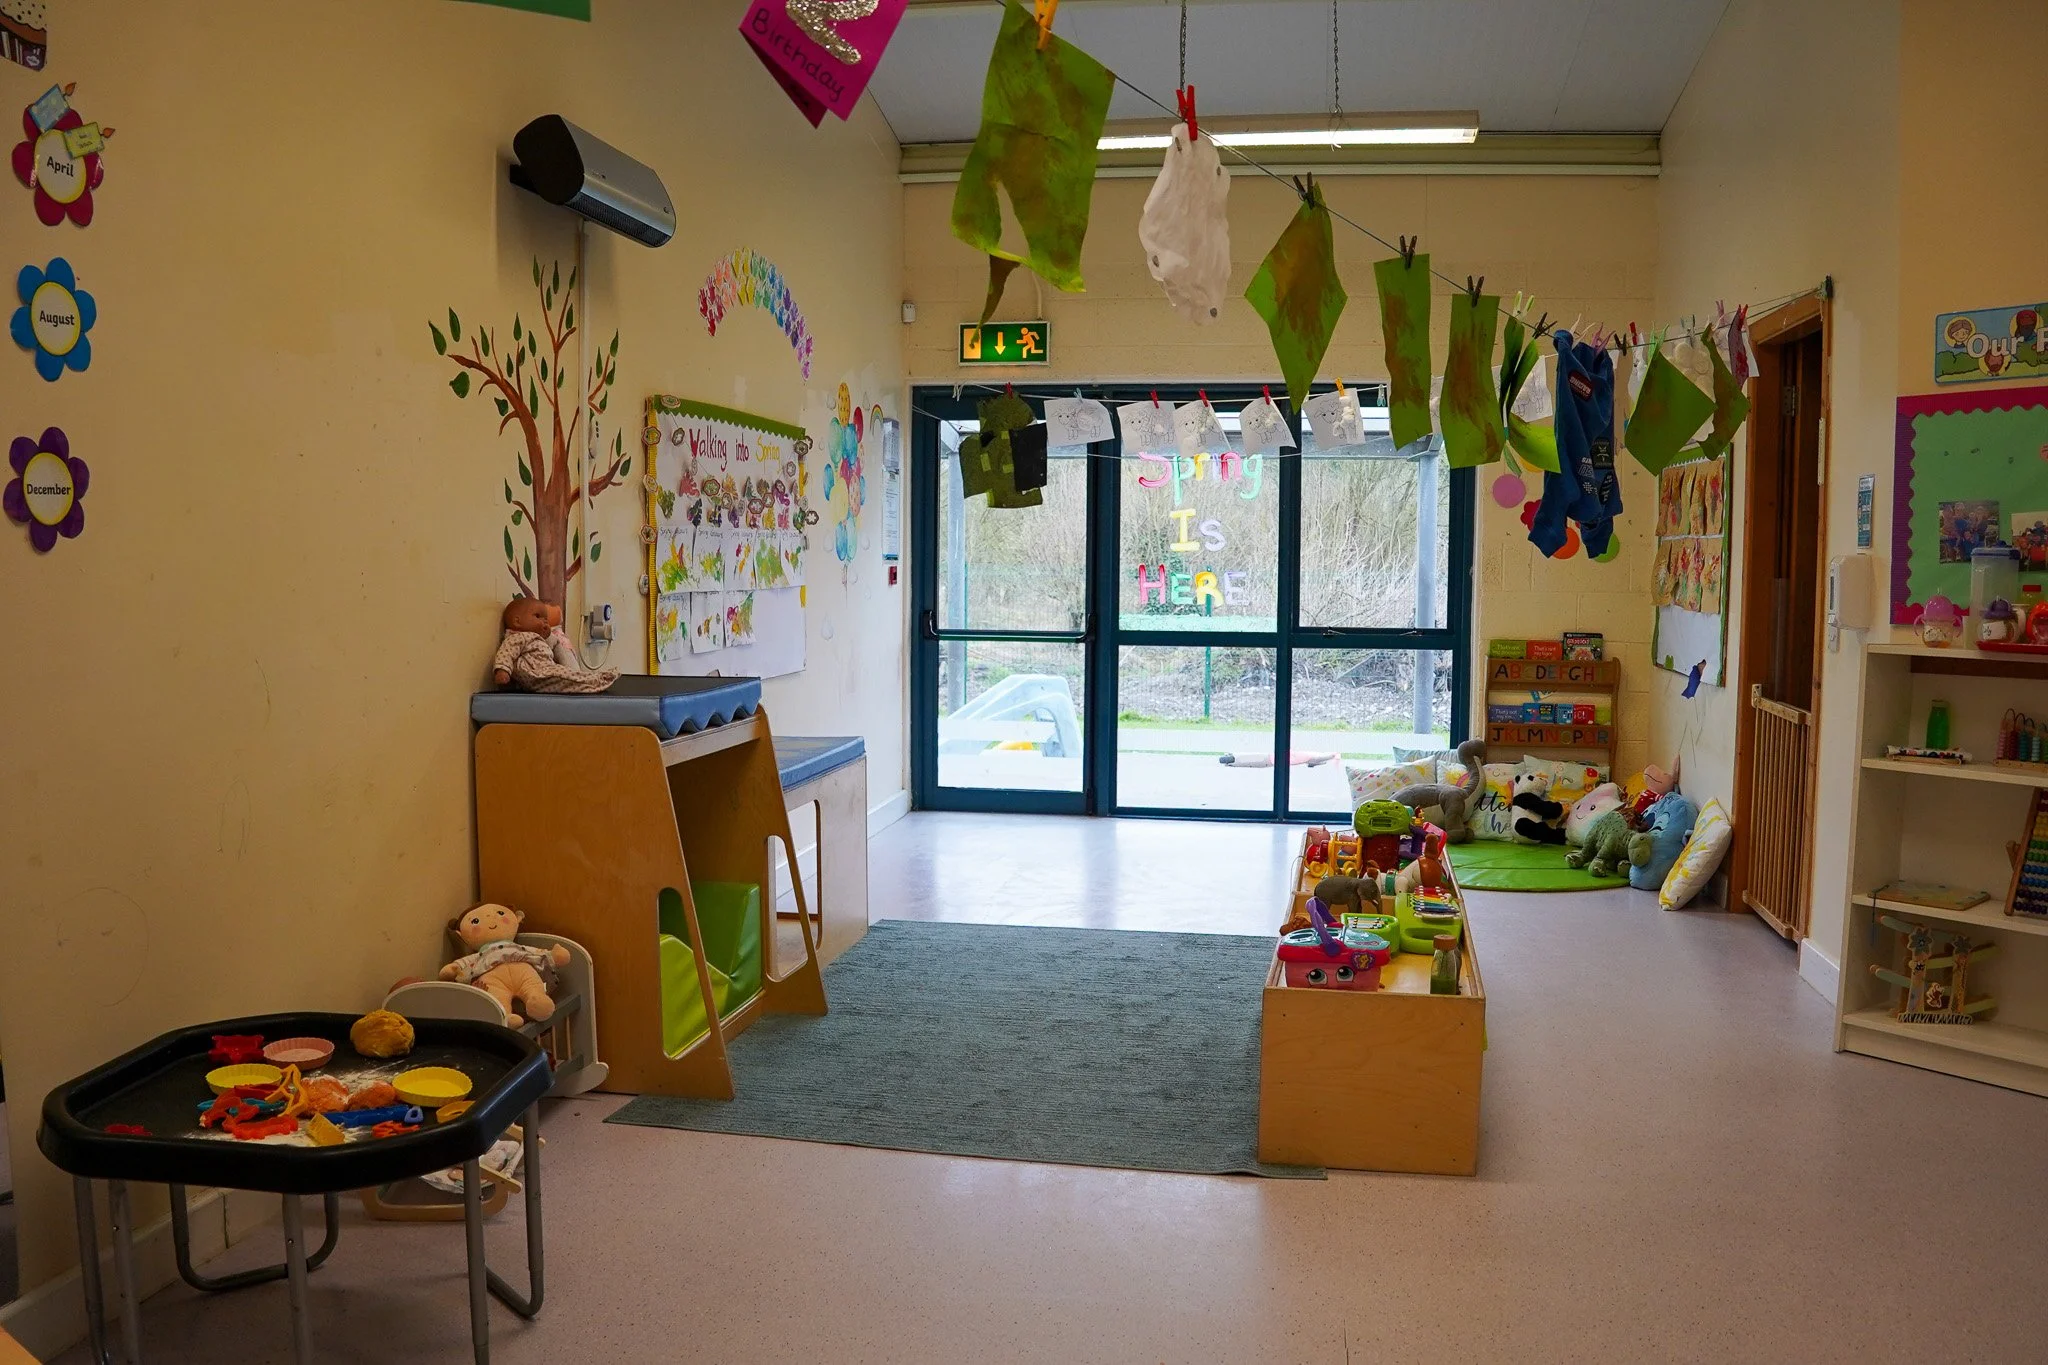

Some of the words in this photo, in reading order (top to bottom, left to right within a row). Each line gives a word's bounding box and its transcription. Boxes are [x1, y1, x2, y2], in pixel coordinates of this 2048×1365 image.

[751, 7, 845, 103] Birthday
[47, 156, 74, 177] April
[39, 310, 75, 327] August
[1966, 332, 2025, 358] Our
[689, 425, 728, 472] Walking
[735, 433, 750, 461] into
[755, 434, 780, 474] Spring
[26, 483, 72, 496] December
[1138, 563, 1250, 609] HERE
